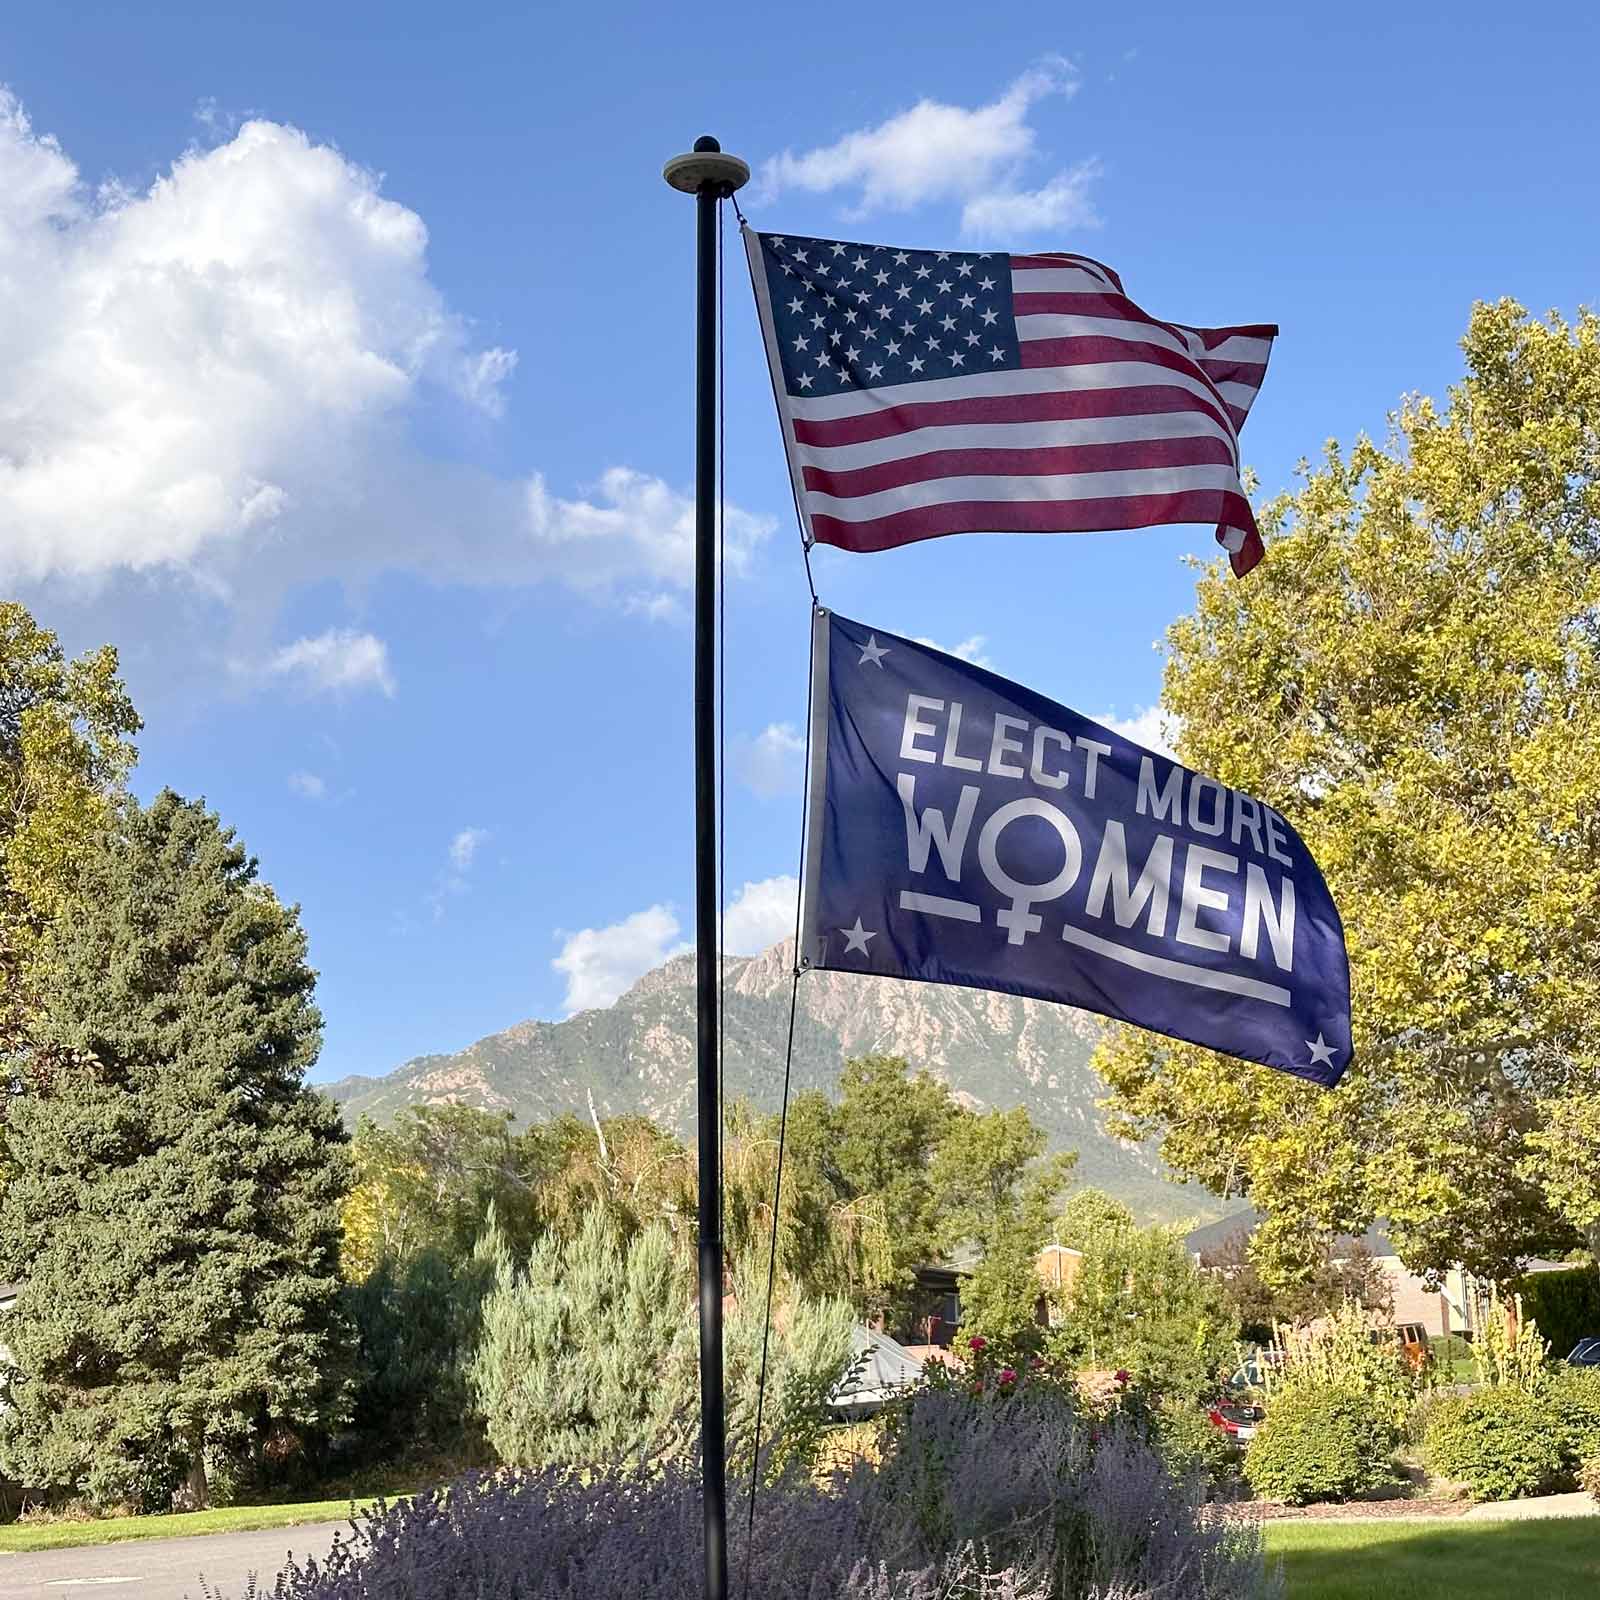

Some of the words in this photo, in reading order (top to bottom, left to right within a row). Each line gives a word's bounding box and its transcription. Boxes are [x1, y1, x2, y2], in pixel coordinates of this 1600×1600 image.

[898, 774, 1296, 971] WOMEN
[899, 694, 1112, 799] ELECT
[1136, 756, 1293, 868] MORE
